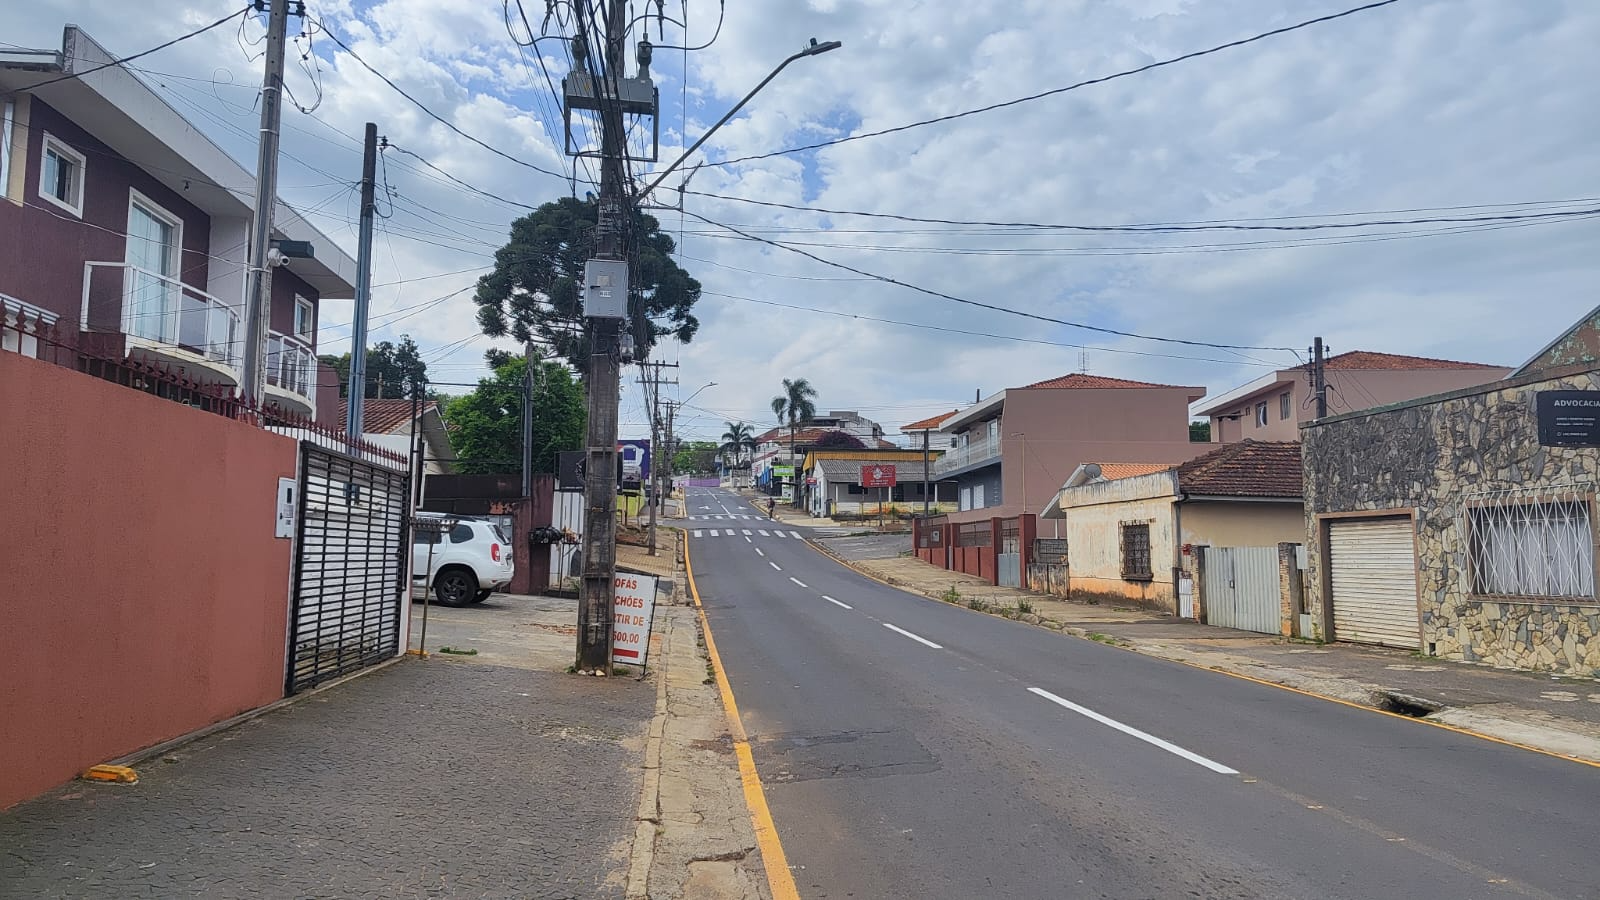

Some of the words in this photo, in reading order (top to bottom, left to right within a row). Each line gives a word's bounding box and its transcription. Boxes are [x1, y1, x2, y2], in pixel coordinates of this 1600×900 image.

[615, 577, 637, 589] OFÁS
[615, 595, 643, 608] CHÕES
[613, 613, 630, 624] TIR
[633, 616, 644, 626] DE
